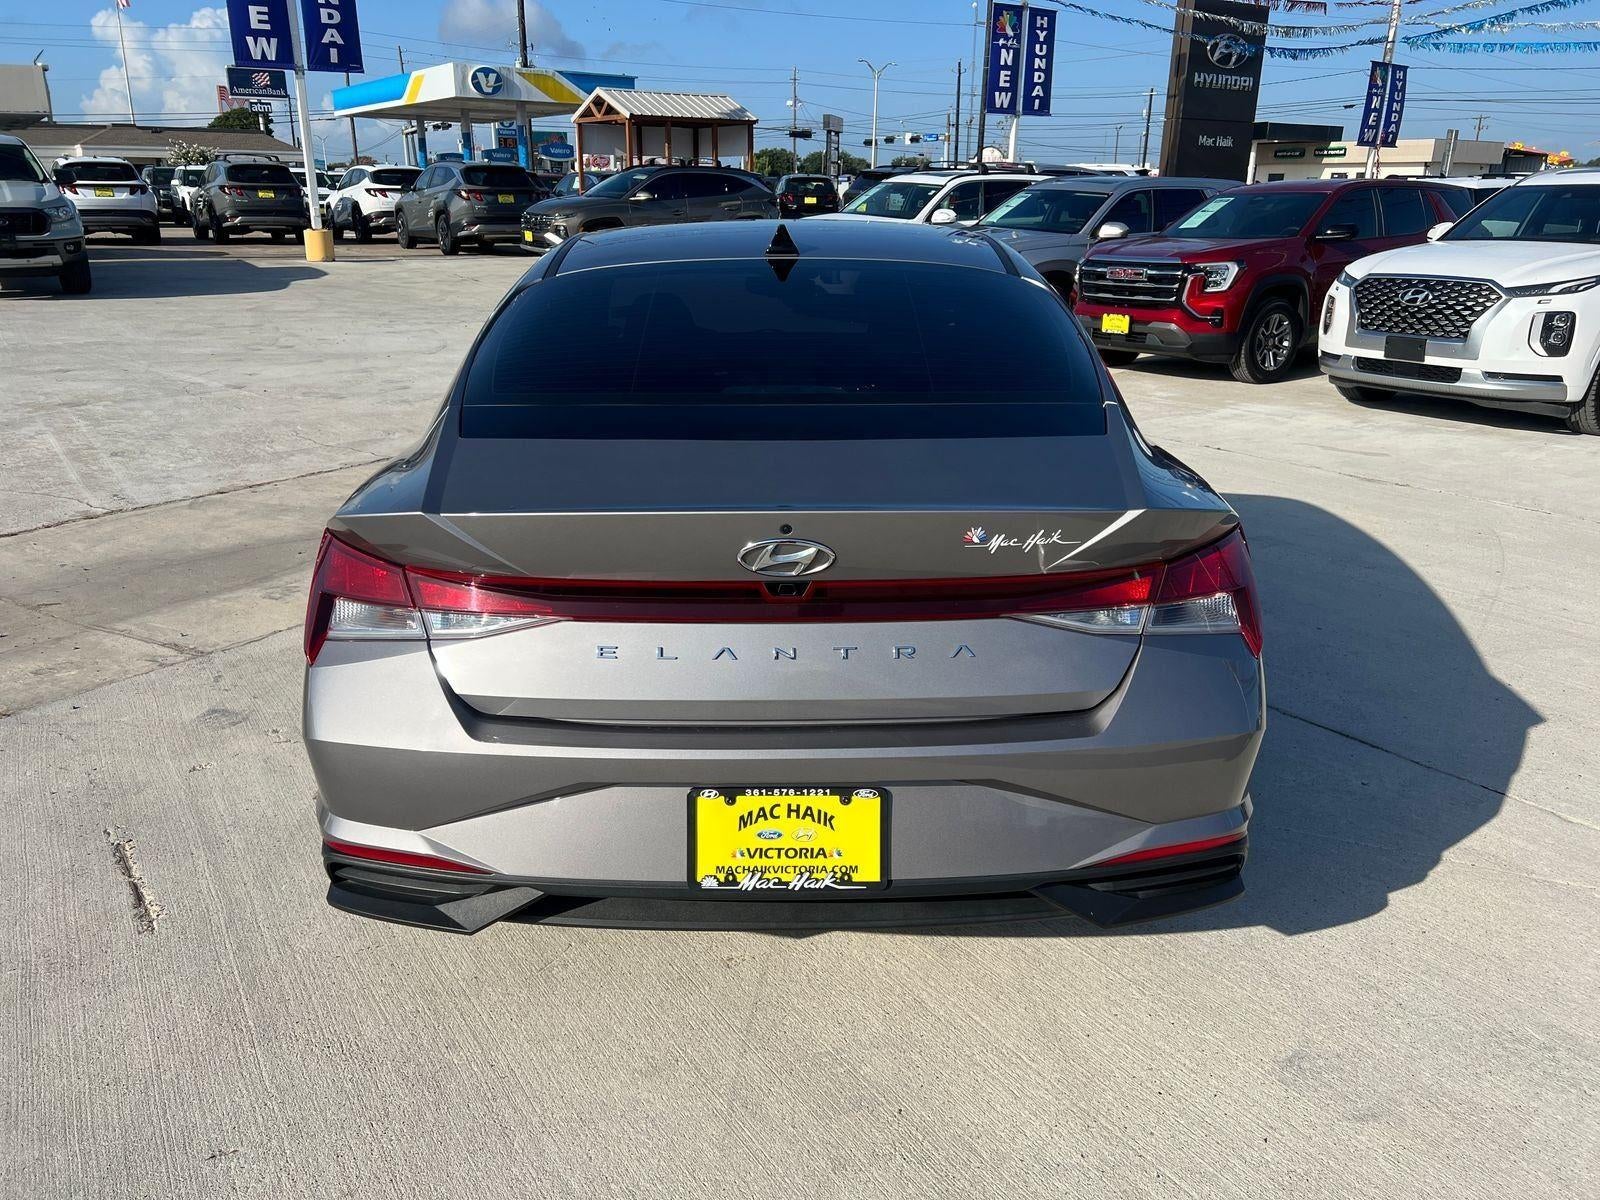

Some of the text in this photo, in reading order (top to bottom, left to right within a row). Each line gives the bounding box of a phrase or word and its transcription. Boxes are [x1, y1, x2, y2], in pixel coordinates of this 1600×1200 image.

[1031, 16, 1048, 110] HYUNDAI
[994, 48, 1014, 109] NEW
[1193, 72, 1253, 91] HYUNDAI
[232, 86, 286, 96] AmericanBank
[251, 103, 272, 112] atm
[1387, 70, 1403, 143] HYUNDAI
[1363, 95, 1381, 142] NEW
[1198, 134, 1234, 147] Mac Haik
[987, 529, 1066, 554] Mac Haik
[596, 644, 976, 660] ELANTRA
[745, 788, 831, 797] 361-576-1221
[738, 803, 836, 832] MAC HAIK
[760, 830, 780, 839] Ford
[746, 847, 828, 859] VICTORIA
[715, 865, 859, 875] MACHAIKVICTORIA.COM
[739, 871, 842, 890] Mac Haik
